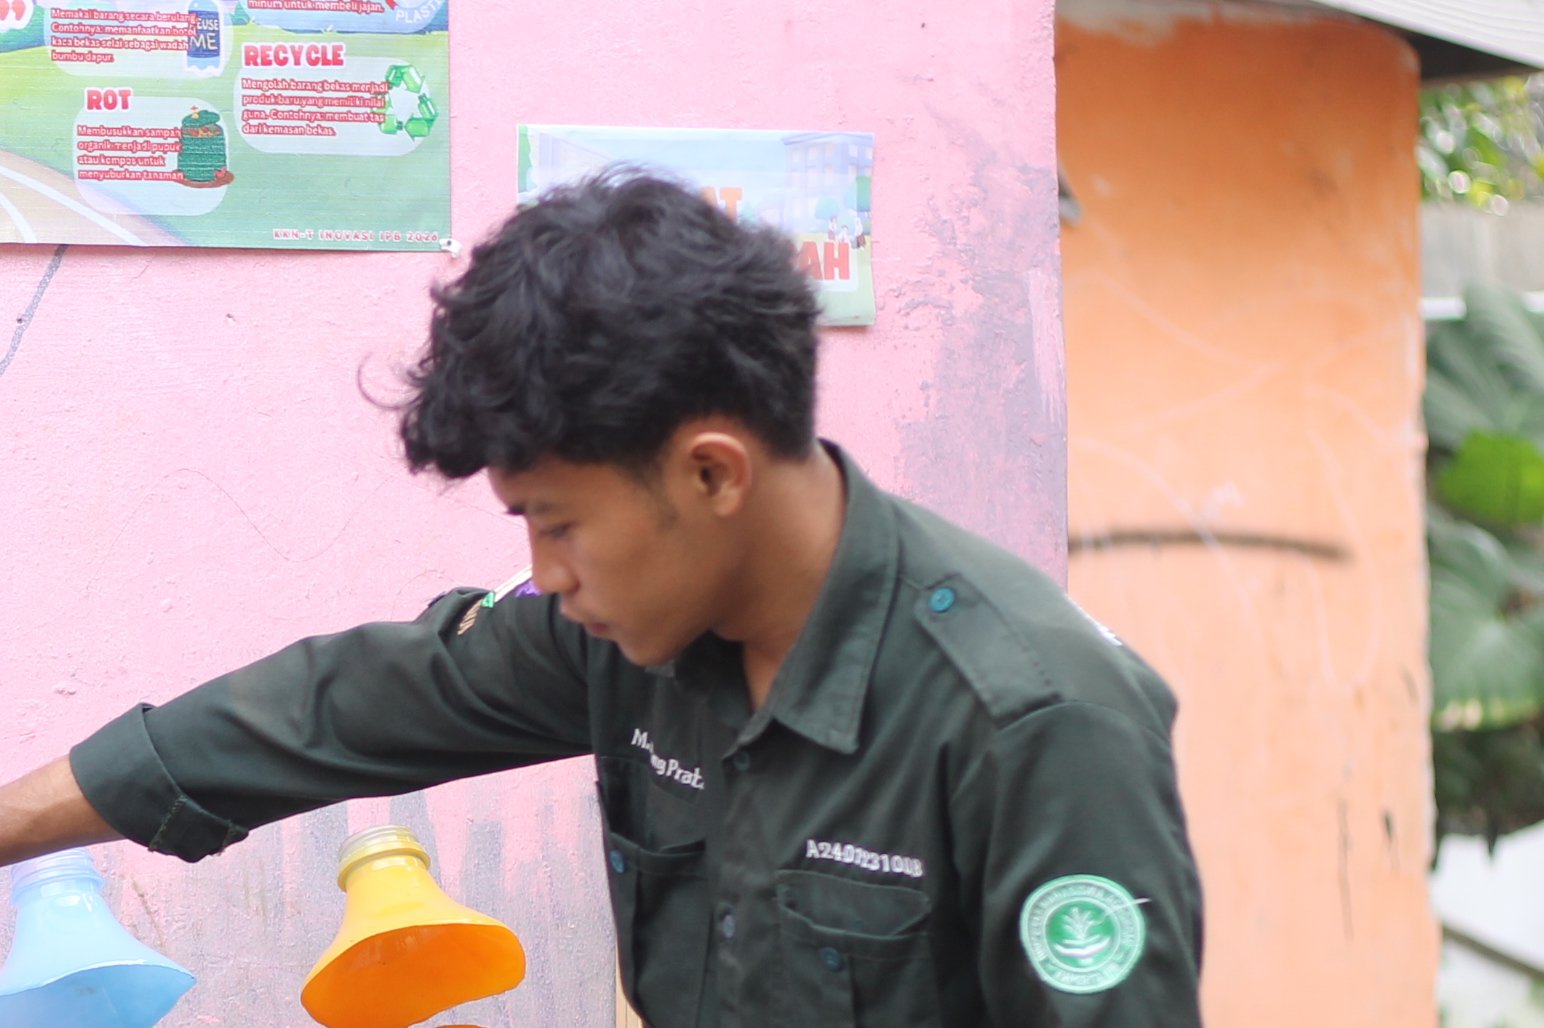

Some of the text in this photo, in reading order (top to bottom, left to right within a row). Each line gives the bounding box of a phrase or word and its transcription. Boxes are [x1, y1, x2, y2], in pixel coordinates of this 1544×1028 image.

[93, 10, 125, 23] barang
[125, 11, 155, 21] secara
[194, 17, 219, 31] EUSE
[51, 37, 73, 47] kaca
[73, 37, 100, 47] bekas
[124, 39, 159, 51] sebagai
[159, 40, 189, 50] wadah
[51, 50, 84, 61] bumbu
[243, 44, 345, 67] RECYCLE
[242, 78, 389, 94] Mengolah barang bekas menjadi
[86, 89, 132, 111] ROT
[242, 94, 275, 107] produk
[324, 112, 369, 123] membuat
[369, 113, 386, 123] tas
[242, 124, 261, 134] dari
[261, 124, 306, 136] kemasan
[137, 157, 164, 167] untuk
[78, 169, 142, 182] menyuburkan
[274, 230, 439, 242] KKN-T INOVASI IPB 2026
